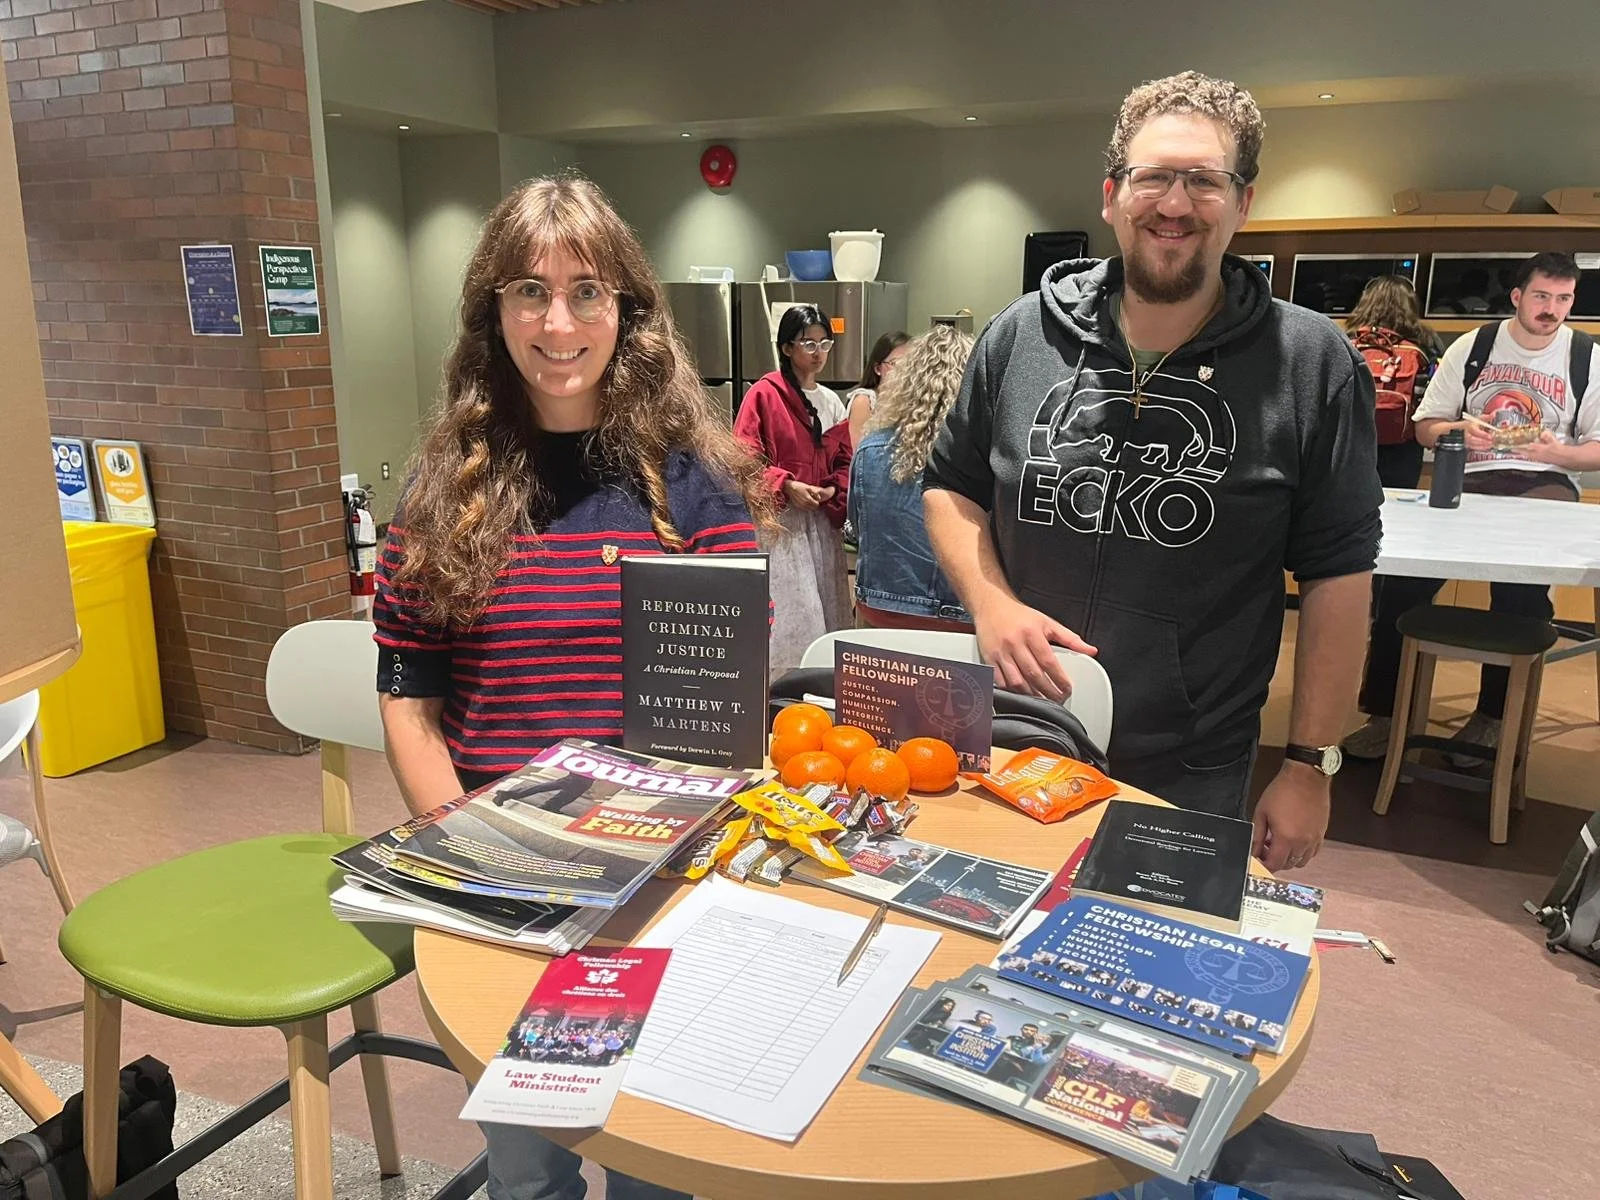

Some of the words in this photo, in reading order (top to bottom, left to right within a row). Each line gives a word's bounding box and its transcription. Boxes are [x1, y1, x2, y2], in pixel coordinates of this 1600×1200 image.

[265, 253, 300, 265] Indigenous
[266, 264, 308, 276] Perspectives
[1522, 367, 1565, 411] FOUR
[1018, 460, 1215, 548] ECKO
[641, 599, 742, 618] REFORMING
[648, 621, 735, 639] CRIMINAL
[656, 643, 726, 659] JUSTICE
[643, 664, 652, 673] A
[653, 664, 697, 677] Christian
[698, 668, 740, 680] Proposal
[842, 652, 909, 673] CHRISTIAN
[912, 664, 952, 681] LEGAL
[842, 664, 919, 687] FELLOWSHIP
[842, 680, 879, 693] JUSTICE.
[638, 694, 724, 713] MATTHEW
[731, 701, 746, 714] T.
[842, 689, 900, 707] COMPASSION.
[842, 700, 884, 713] HUMILITY.
[652, 716, 732, 734] MARTENS
[842, 708, 888, 724] INTEGRITY.
[842, 717, 895, 735] EXCELLENCE.
[650, 743, 678, 752] Foreword
[679, 745, 687, 754] by
[688, 746, 710, 755] Derwin
[718, 750, 733, 758] Gray
[531, 745, 740, 798] Journal
[600, 809, 661, 825] Walking
[664, 817, 687, 827] by
[581, 817, 674, 839] Faith
[1133, 822, 1147, 830] No
[1150, 825, 1181, 835] Higher
[1182, 831, 1215, 843] Calling
[1076, 921, 1130, 942] JUSTICE.
[1083, 912, 1195, 950] FELLOWSHIP
[1089, 904, 1187, 939] CHRISTIAN
[1189, 931, 1247, 956] LEGAL
[1061, 940, 1129, 966] INTEGRITY.
[1066, 934, 1128, 958] HUMILITY.
[1071, 928, 1157, 959] COMPASSION.
[582, 961, 632, 970] Fellowship
[618, 957, 643, 966] Legal
[1056, 947, 1135, 976] EXCELLENCE.
[504, 1069, 538, 1080] Law
[540, 1072, 602, 1085] Student
[509, 1080, 589, 1094] Ministries
[1063, 1080, 1127, 1109] CLF
[1043, 1096, 1105, 1122] CONFERENCE
[1047, 1088, 1124, 1123] National
